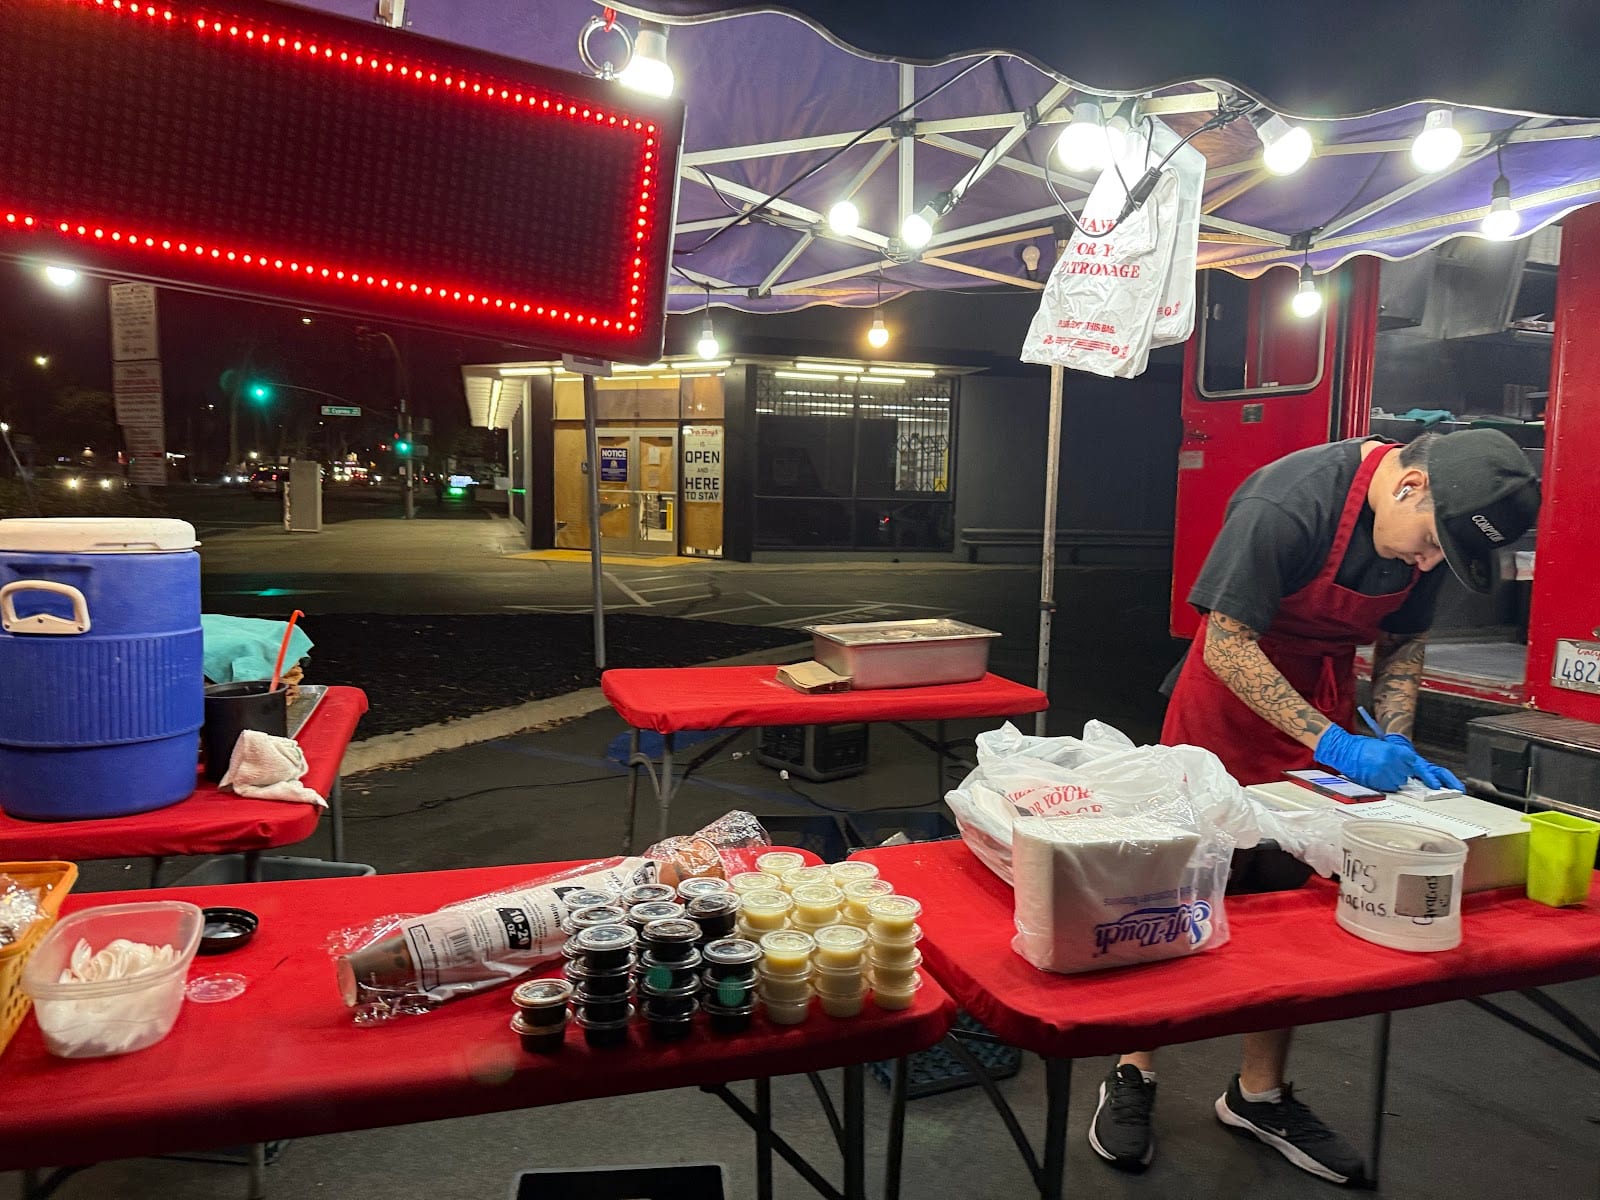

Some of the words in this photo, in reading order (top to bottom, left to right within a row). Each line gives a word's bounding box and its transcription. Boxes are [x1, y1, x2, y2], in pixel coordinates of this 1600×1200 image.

[601, 449, 627, 458] NOTICE
[685, 450, 720, 463] OPEN
[685, 477, 720, 490] HERE
[685, 491, 697, 500] TO
[698, 491, 719, 500] STAY
[1561, 658, 1600, 684] 482
[506, 923, 518, 937] OZ
[508, 909, 530, 945] 10-20
